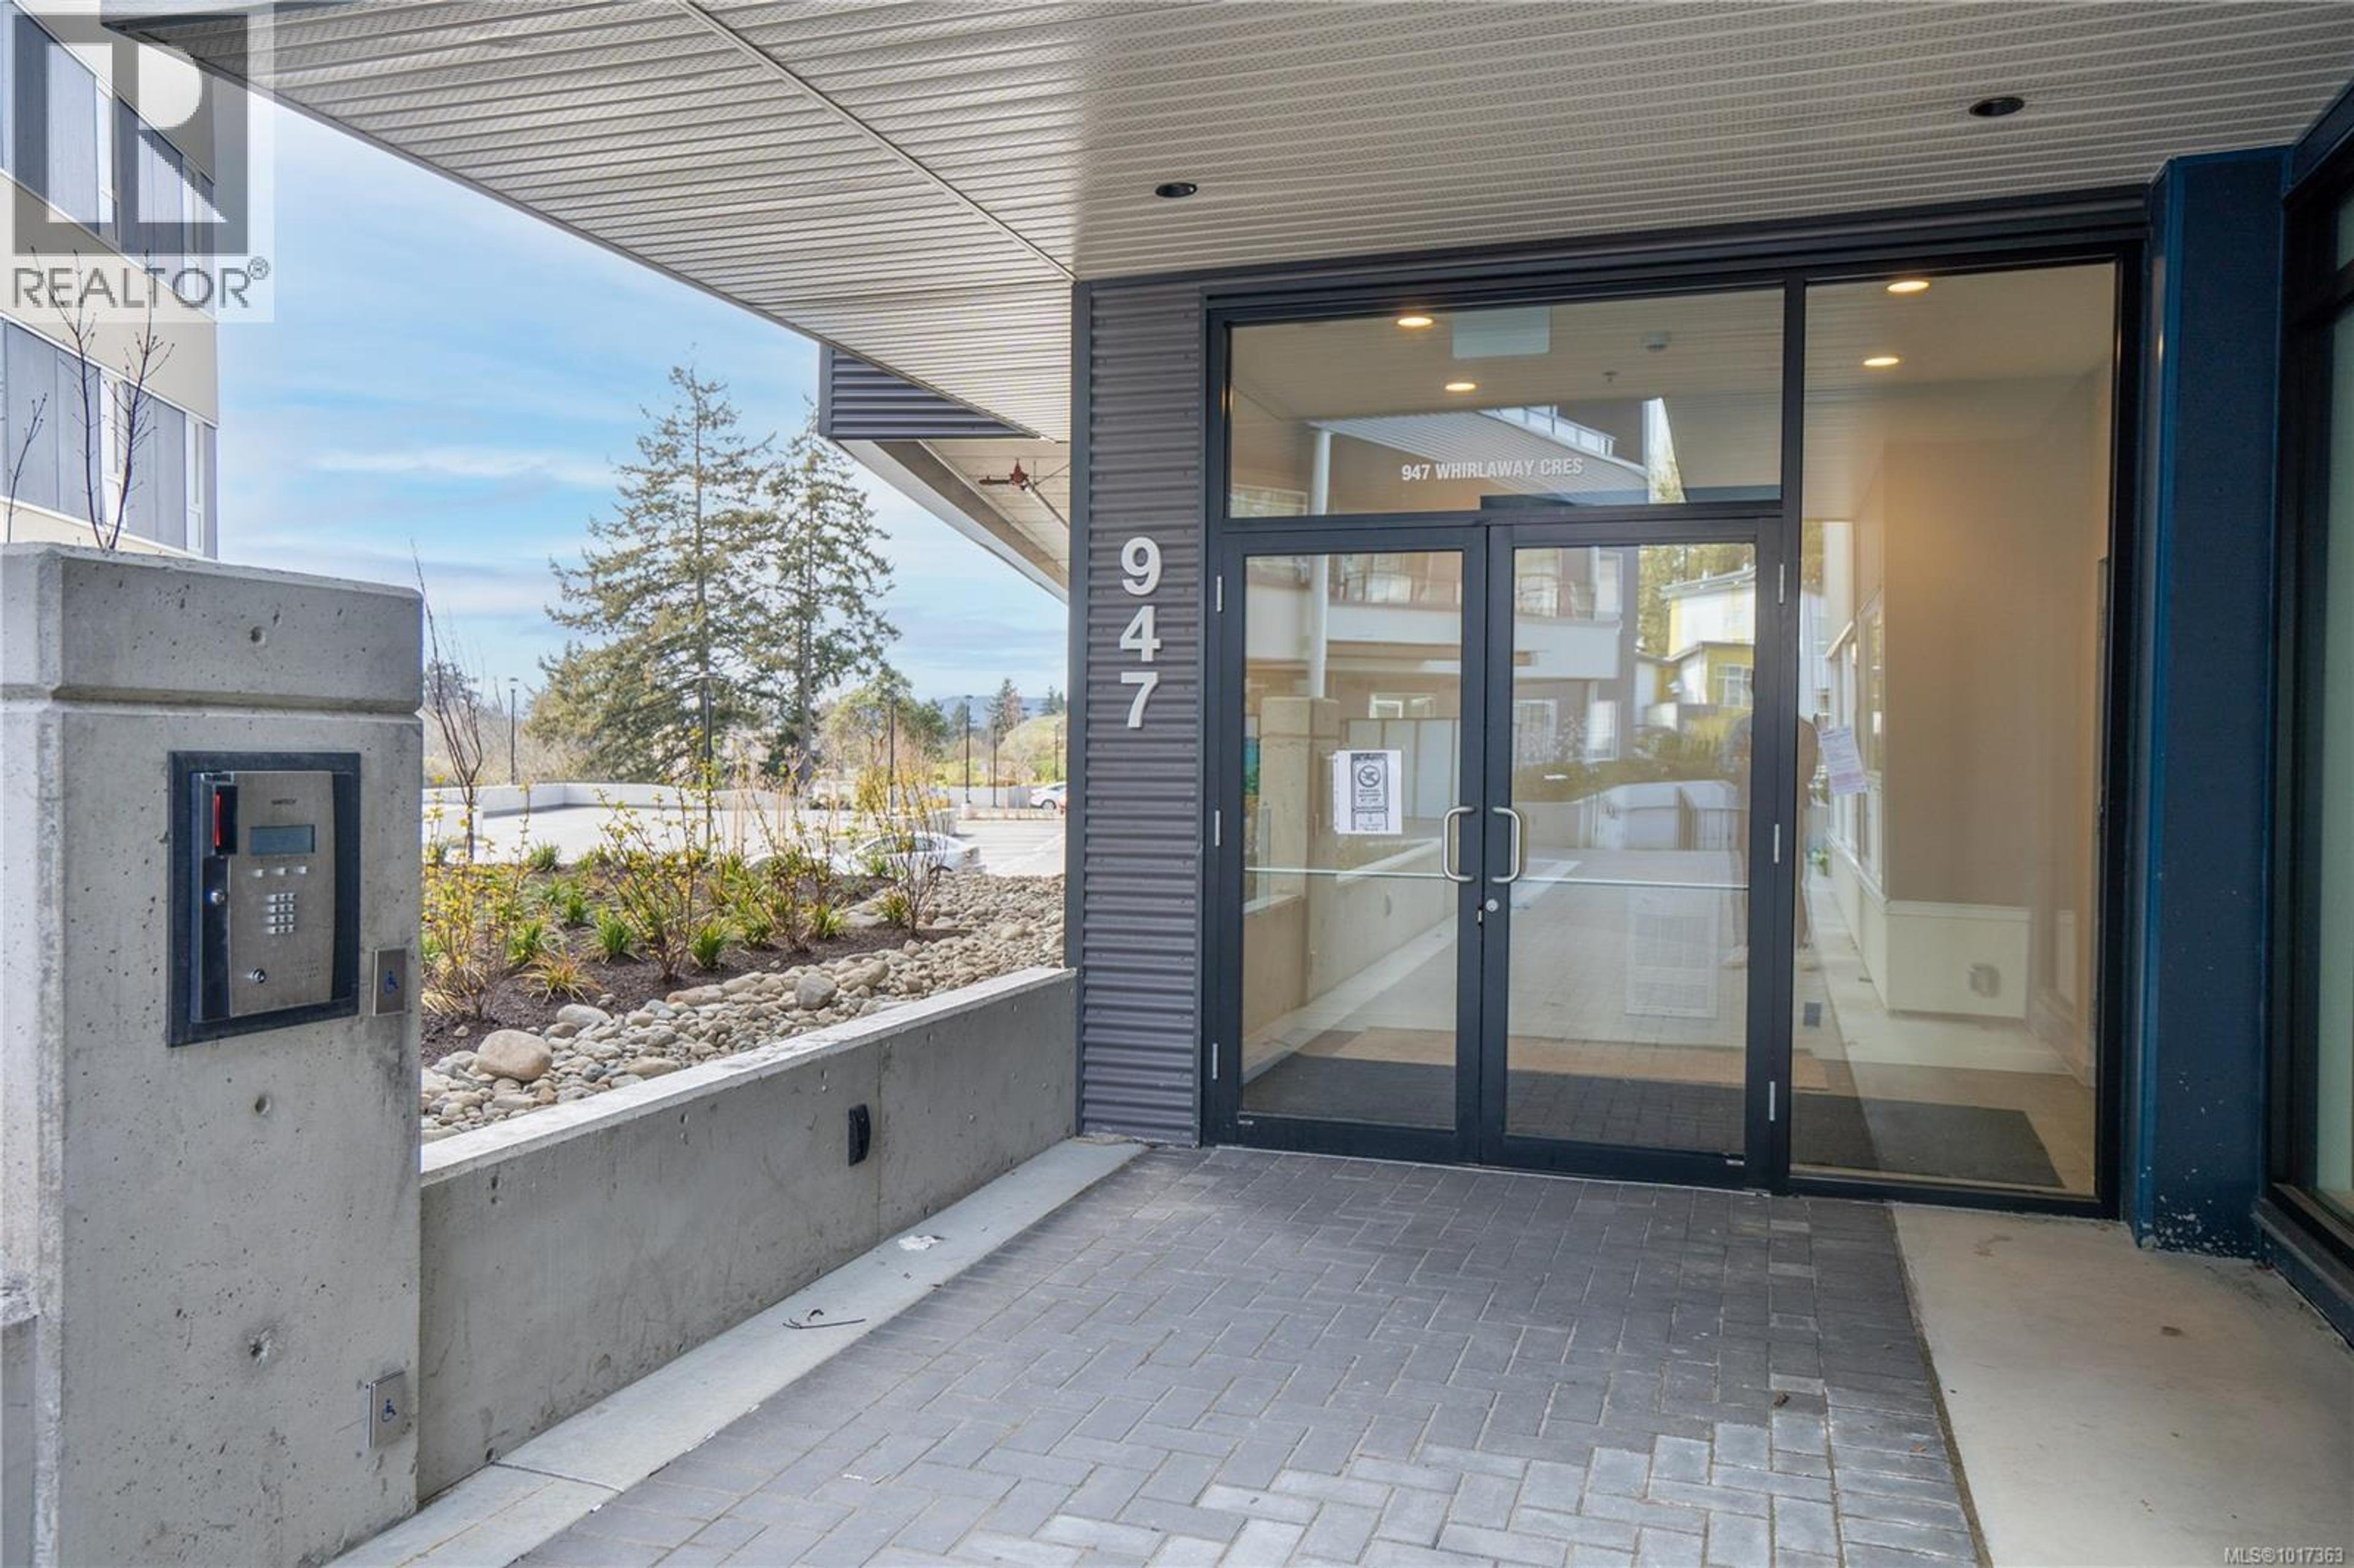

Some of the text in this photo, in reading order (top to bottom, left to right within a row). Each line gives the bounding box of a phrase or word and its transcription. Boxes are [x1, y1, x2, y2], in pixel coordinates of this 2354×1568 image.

[1401, 458, 1583, 481] 947 WHIRLAWAY CRES
